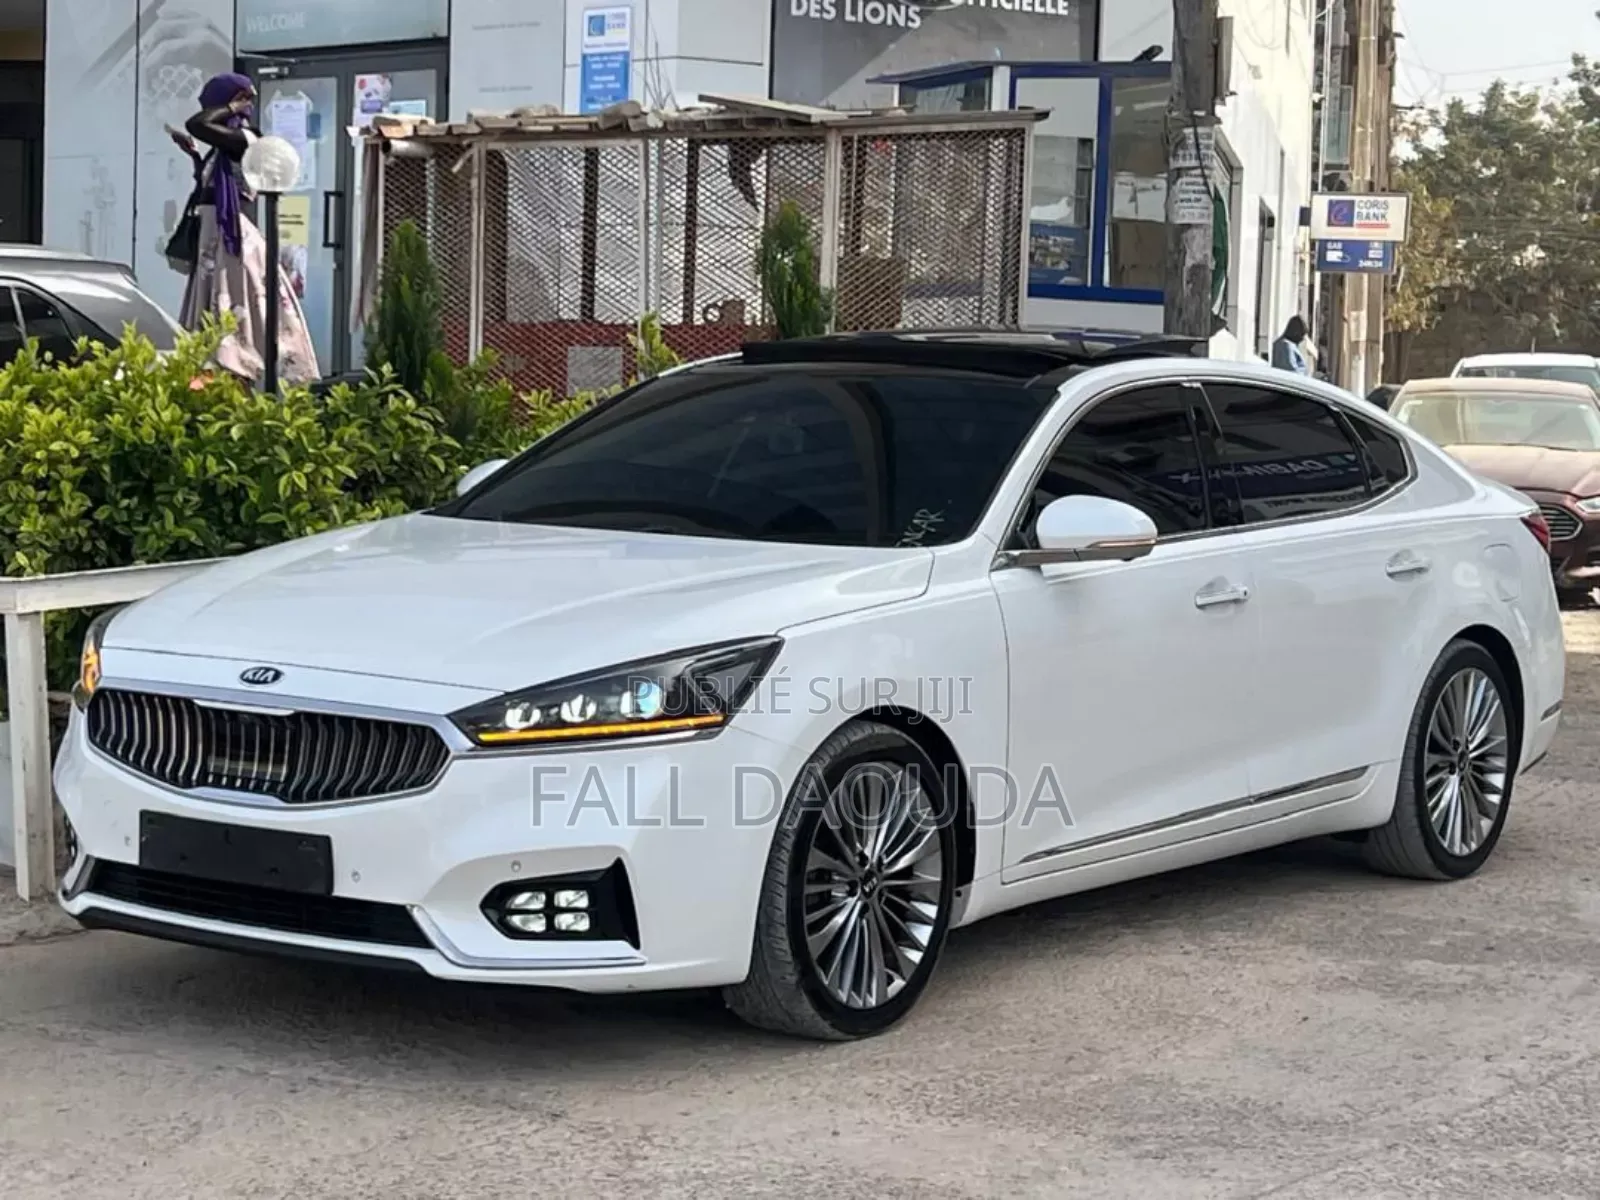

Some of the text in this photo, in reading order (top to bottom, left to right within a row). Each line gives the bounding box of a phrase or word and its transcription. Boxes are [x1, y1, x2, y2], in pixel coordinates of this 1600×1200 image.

[790, 0, 921, 29] DES LIONS
[1356, 199, 1389, 210] CORIS
[1356, 211, 1388, 221] BANK
[242, 669, 276, 682] KIA
